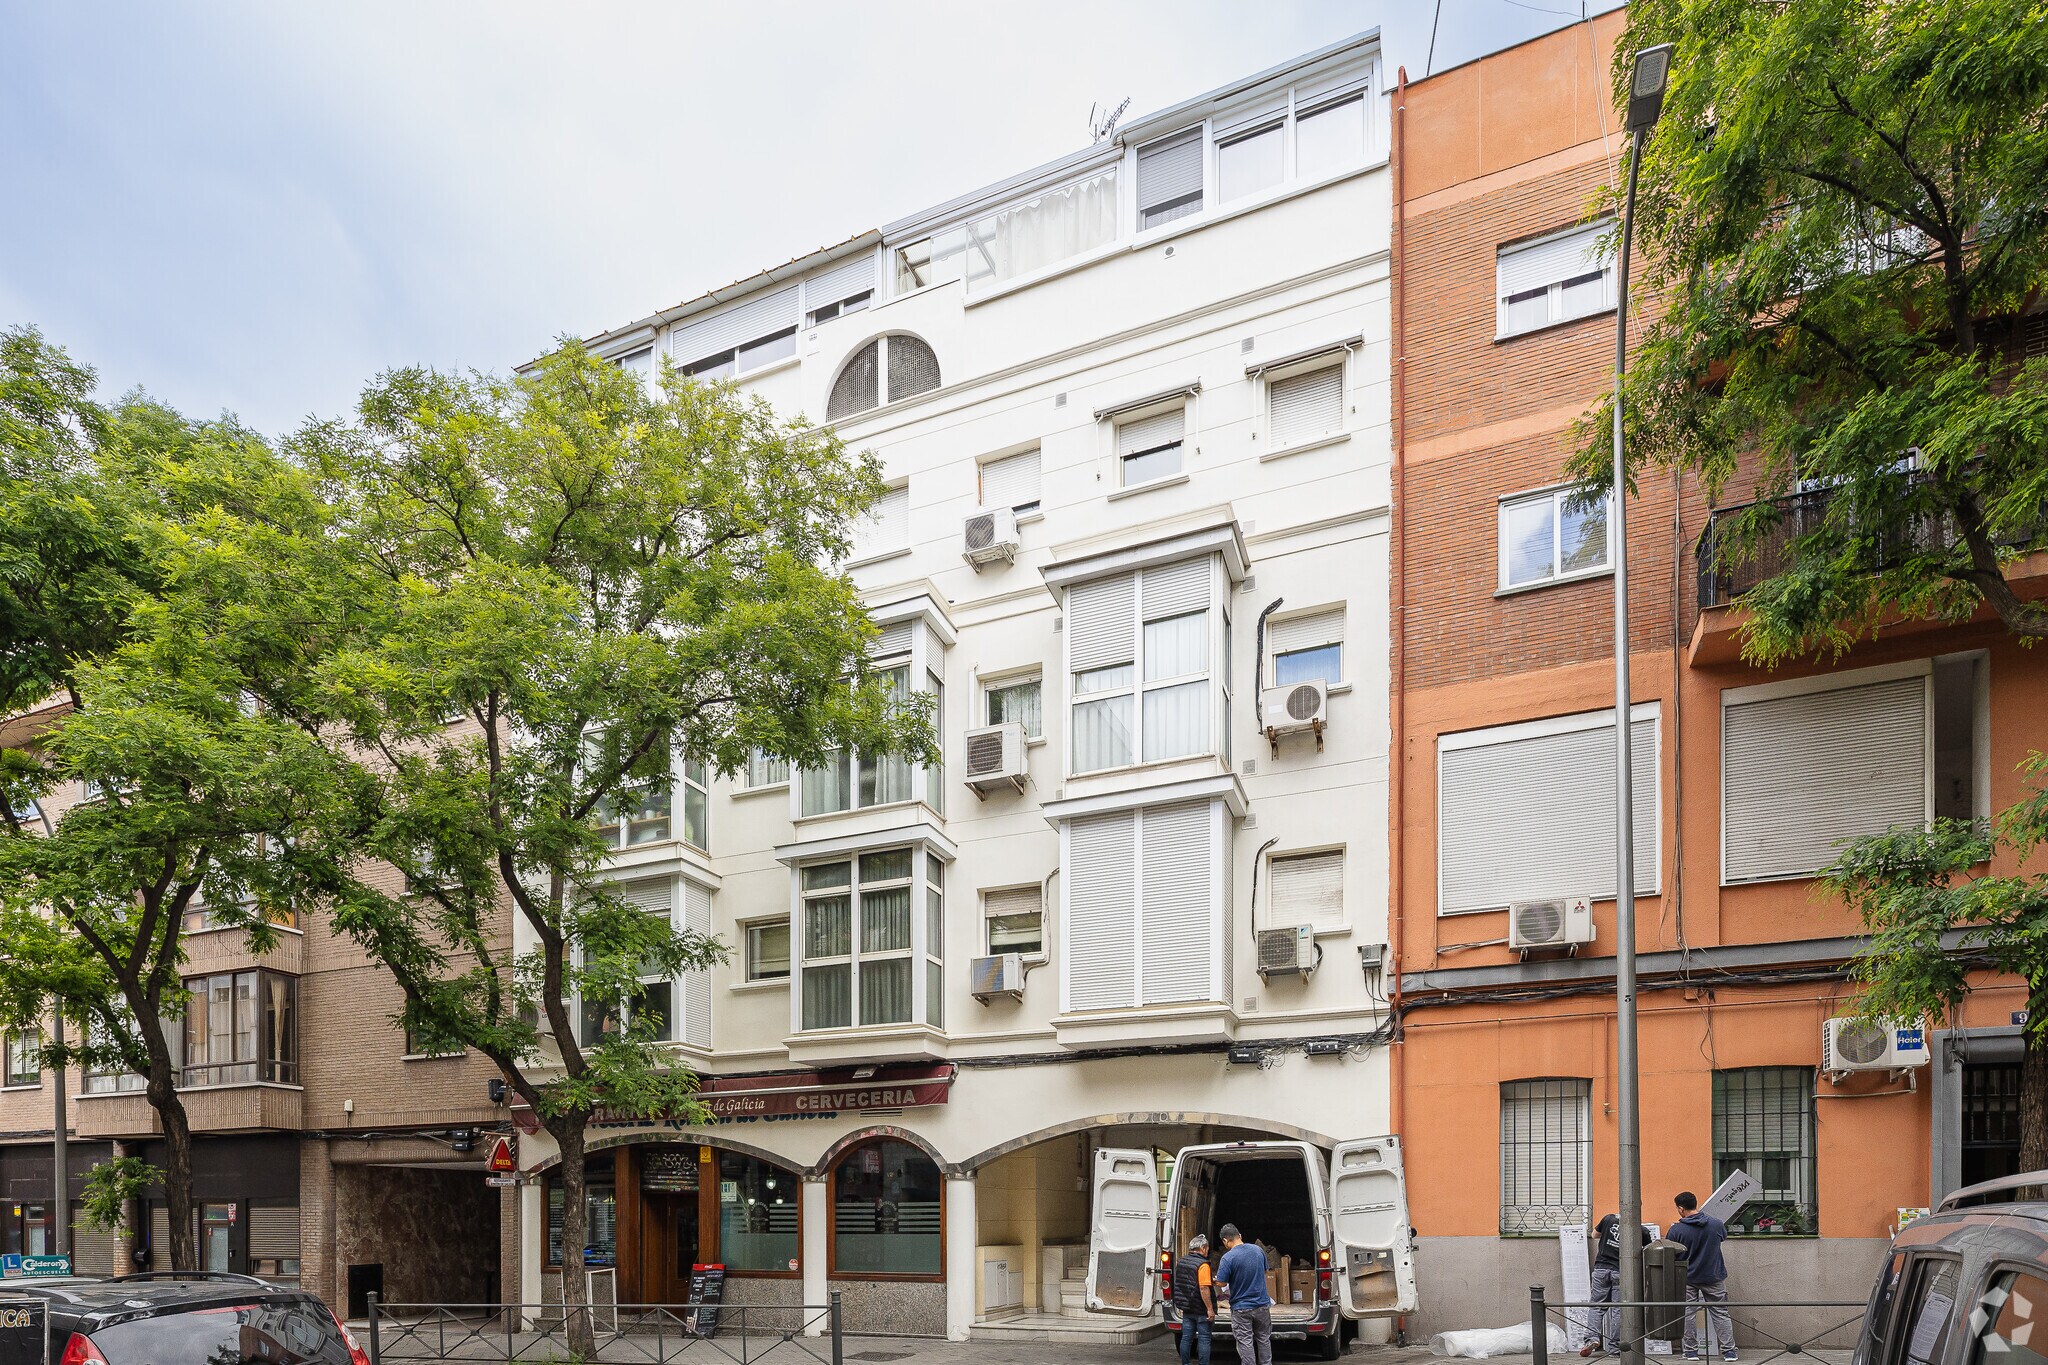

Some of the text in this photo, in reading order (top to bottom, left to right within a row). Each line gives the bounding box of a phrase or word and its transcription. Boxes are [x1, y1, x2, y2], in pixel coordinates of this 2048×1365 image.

[2019, 1012, 2028, 1023] 9
[713, 1099, 725, 1112] de
[726, 1096, 766, 1114] Galicia
[795, 1089, 916, 1110] CERVECERIA
[8, 1257, 17, 1268] L
